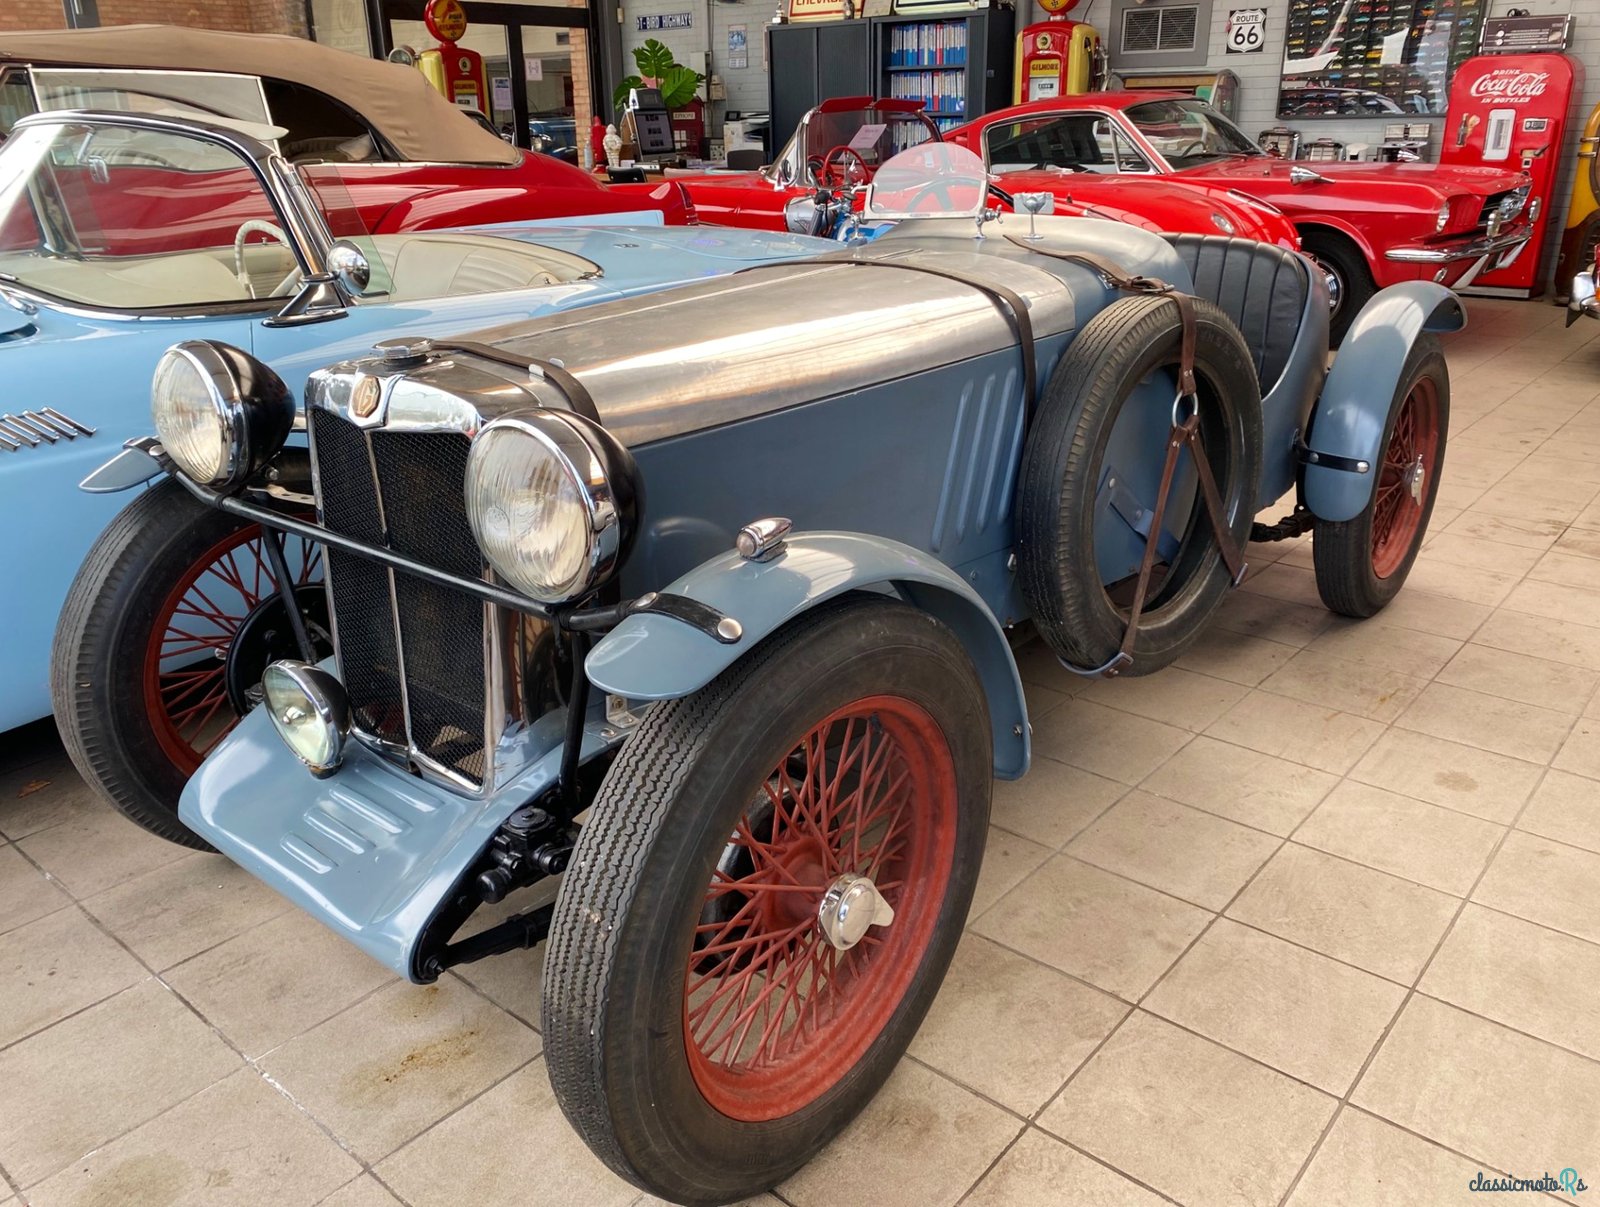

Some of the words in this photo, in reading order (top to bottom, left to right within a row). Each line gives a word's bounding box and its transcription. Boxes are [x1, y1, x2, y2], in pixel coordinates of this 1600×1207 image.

[1234, 25, 1258, 45] 66
[1032, 63, 1058, 71] GILMORE
[1470, 72, 1551, 97] Coca-Cola
